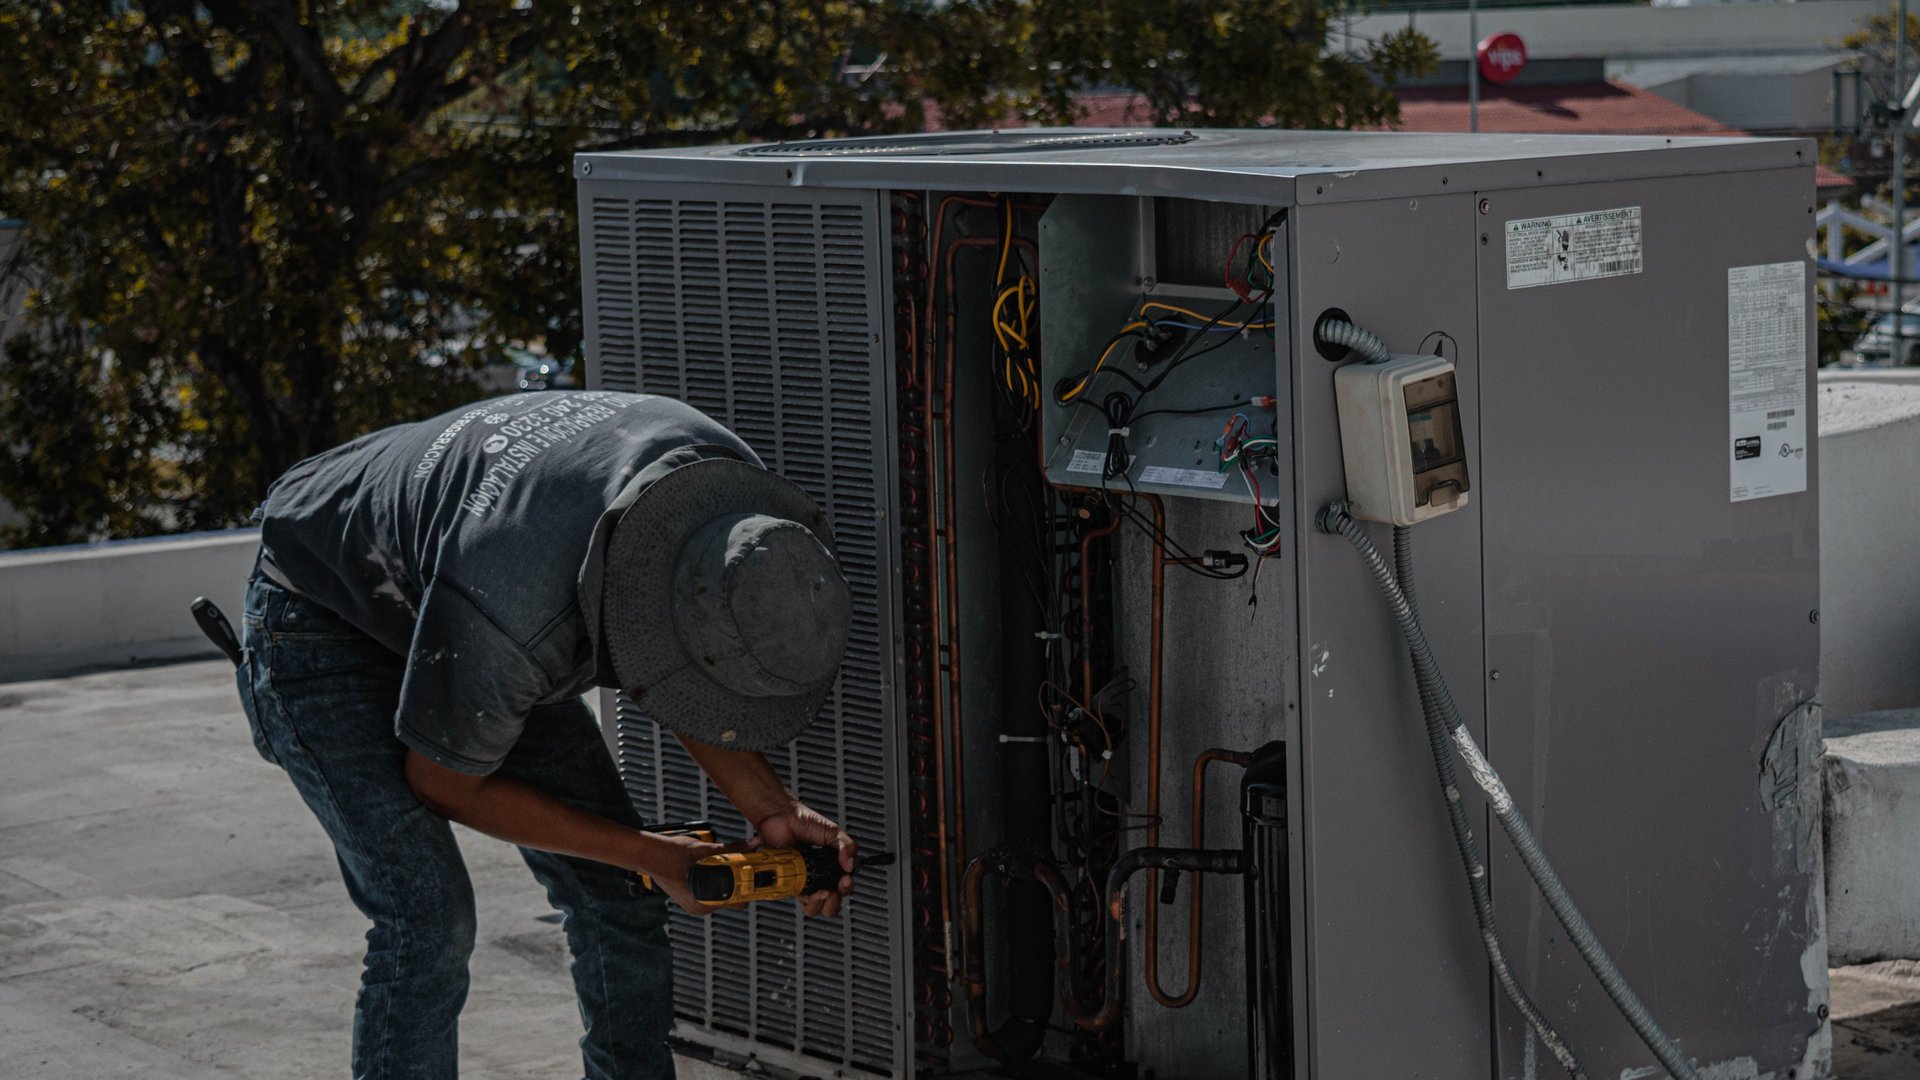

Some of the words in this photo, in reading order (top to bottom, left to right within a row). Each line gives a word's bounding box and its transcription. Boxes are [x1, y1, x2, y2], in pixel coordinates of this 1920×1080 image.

[1521, 220, 1552, 230] WARNING
[1583, 211, 1633, 223] AVERTISSEMENT
[542, 399, 583, 417] 240
[500, 412, 551, 437] 3230
[540, 403, 616, 443] REPARACIÓN
[525, 430, 551, 447] E
[462, 439, 542, 517] INSTALACIÓN
